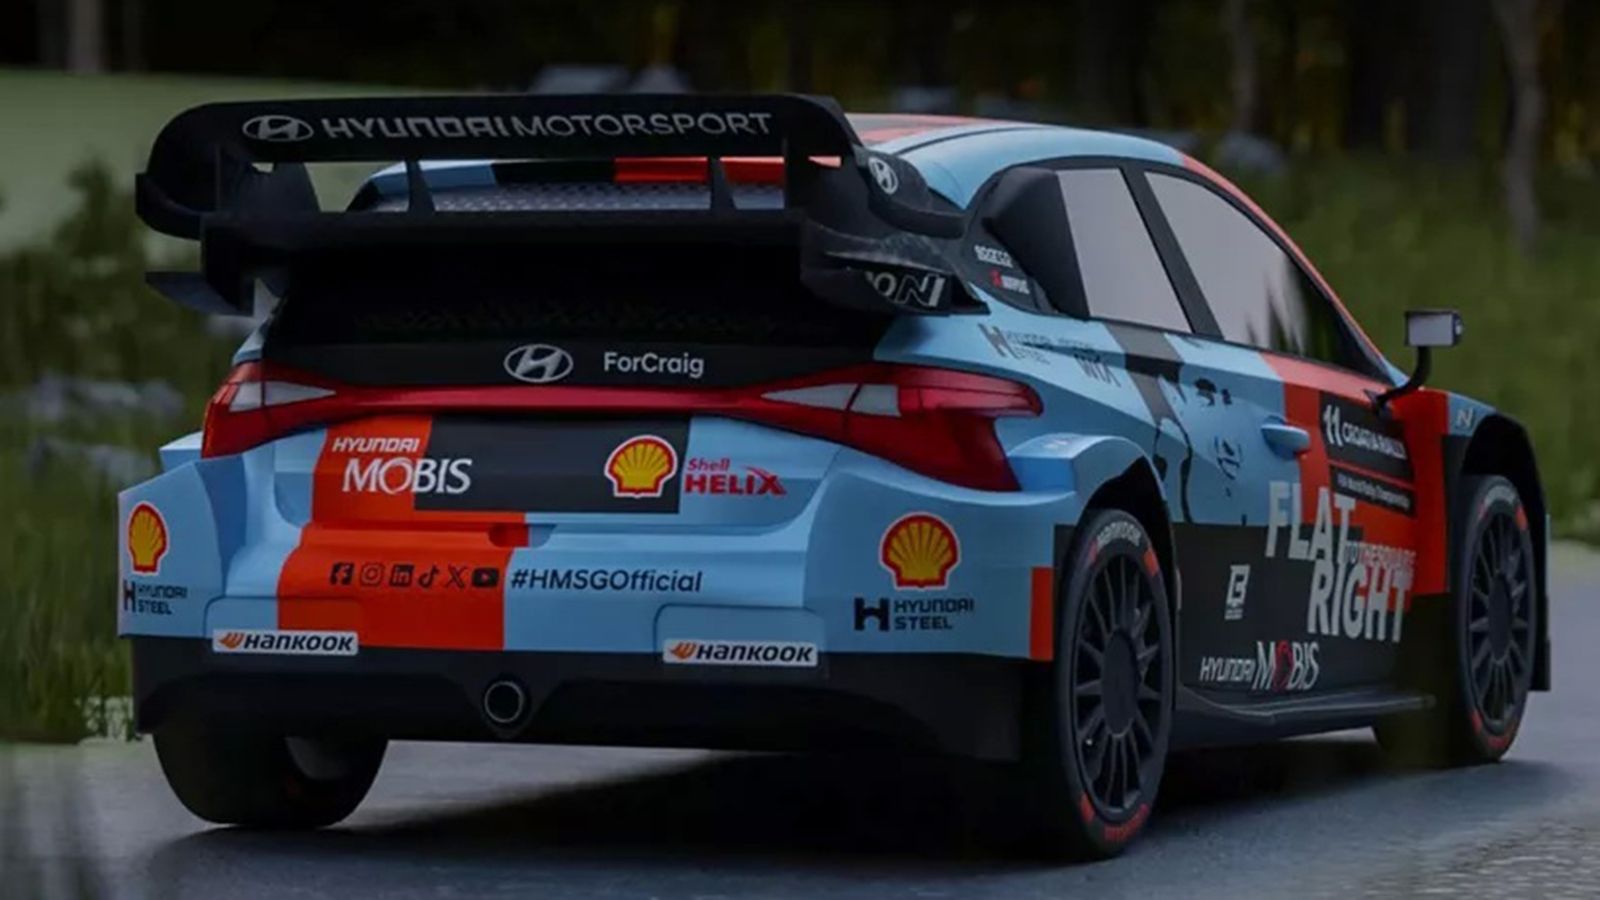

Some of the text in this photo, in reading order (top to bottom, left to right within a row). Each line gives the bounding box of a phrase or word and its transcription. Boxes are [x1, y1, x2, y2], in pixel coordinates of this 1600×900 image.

[320, 111, 772, 139] HYUNDAI MOTORSPORT
[603, 351, 705, 378] ForCraig
[1323, 404, 1344, 447] 11
[331, 436, 420, 453] HYUNDAI
[341, 456, 473, 494] MOBIS
[687, 457, 731, 471] Shell
[684, 465, 787, 495] HELIX
[1264, 480, 1357, 564] FLAT
[510, 569, 703, 592] #HMSGOfficial
[893, 598, 974, 613] HYUNDAI
[1306, 557, 1416, 644] RIGHT
[894, 616, 953, 631] STEEL
[1199, 640, 1320, 692] HYUNDAI MOBIS
